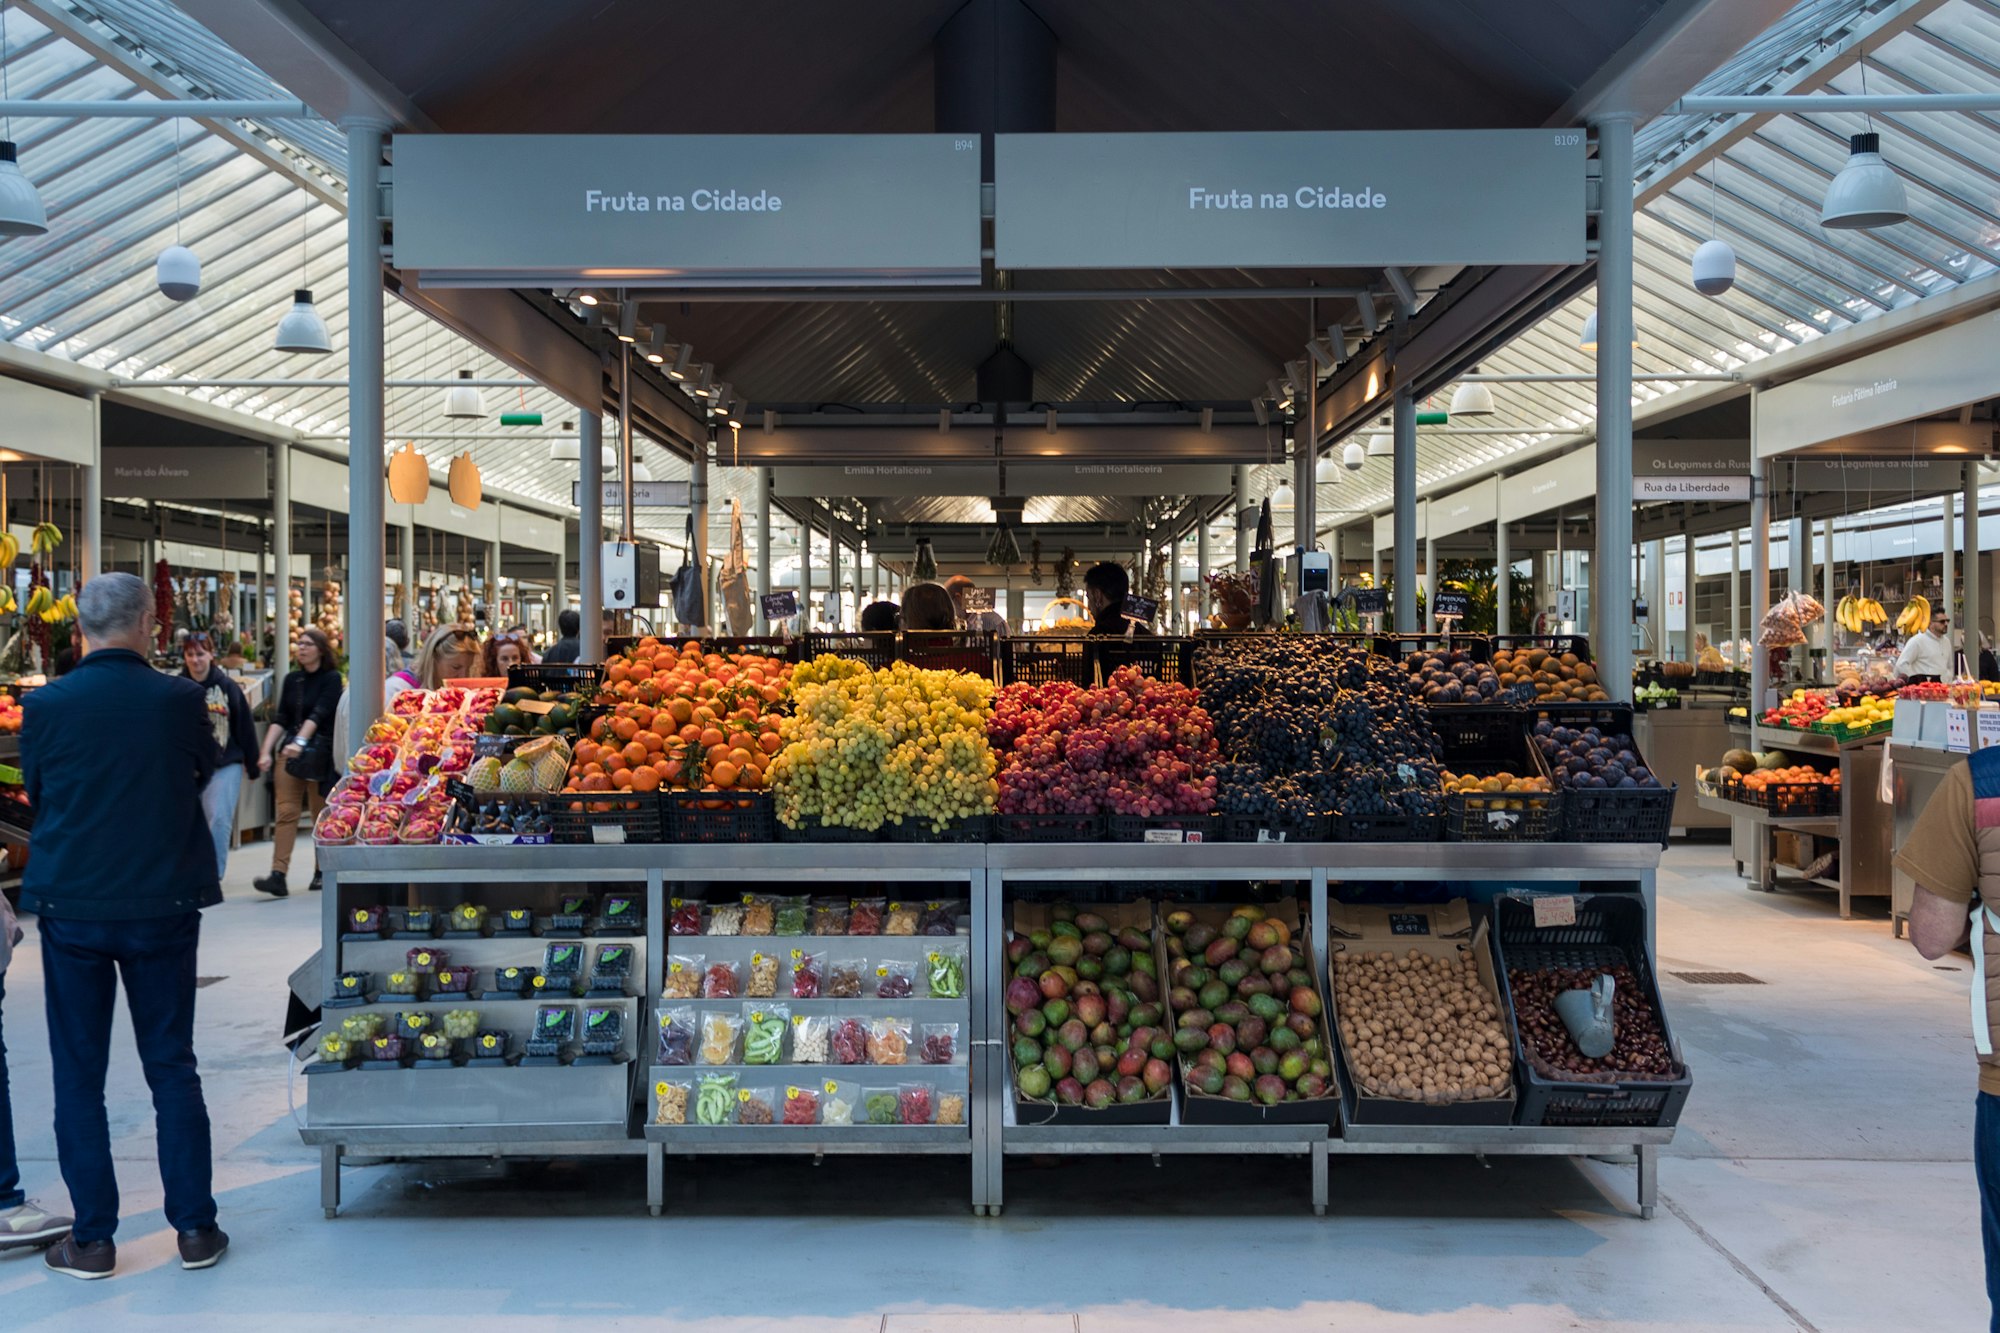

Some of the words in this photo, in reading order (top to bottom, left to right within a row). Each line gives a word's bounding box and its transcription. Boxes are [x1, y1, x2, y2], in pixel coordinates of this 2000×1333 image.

[955, 139, 973, 151] B94
[1554, 135, 1579, 146] B109
[586, 190, 650, 212] Fruta
[657, 195, 685, 212] na
[691, 189, 782, 211] Cidade
[1189, 187, 1253, 209] Fruta
[1260, 193, 1289, 209] na
[1295, 186, 1387, 209] Cidade
[1832, 391, 1854, 408] Frutaria
[1874, 378, 1897, 395] Teixeira
[114, 467, 142, 477] Maria
[144, 467, 157, 477] do
[158, 464, 189, 477] Álvaro
[1652, 460, 1666, 469] Os
[1668, 460, 1713, 471] Legumes
[1714, 459, 1727, 469] da
[1728, 460, 1751, 469] Russ
[1841, 461, 1884, 470] Legumes
[605, 488, 618, 498] da
[1644, 483, 1663, 492] Rua
[1665, 482, 1677, 492] da
[1680, 482, 1730, 492] Liberdade
